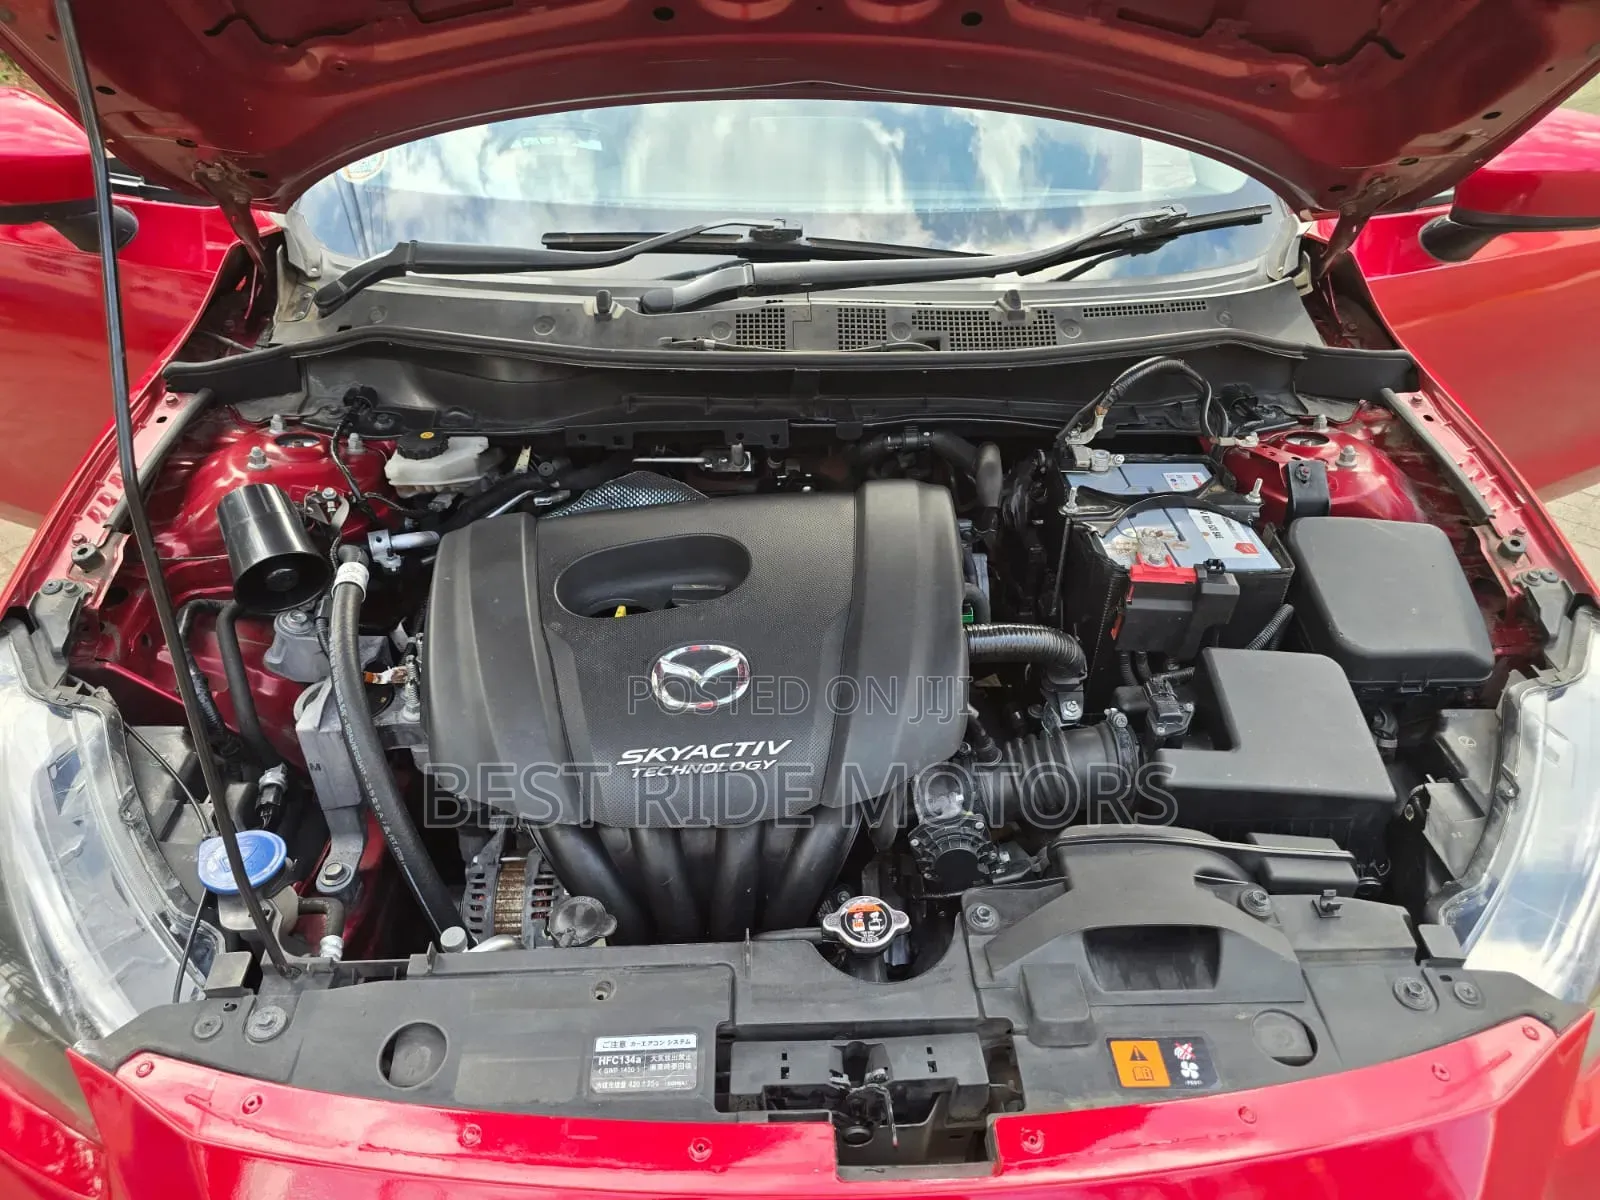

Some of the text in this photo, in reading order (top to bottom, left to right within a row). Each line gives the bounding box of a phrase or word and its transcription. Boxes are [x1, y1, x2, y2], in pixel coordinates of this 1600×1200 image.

[616, 739, 793, 766] SKYACTIV
[632, 759, 778, 779] TECHNOLOGY
[598, 1055, 642, 1066] HFC134a
